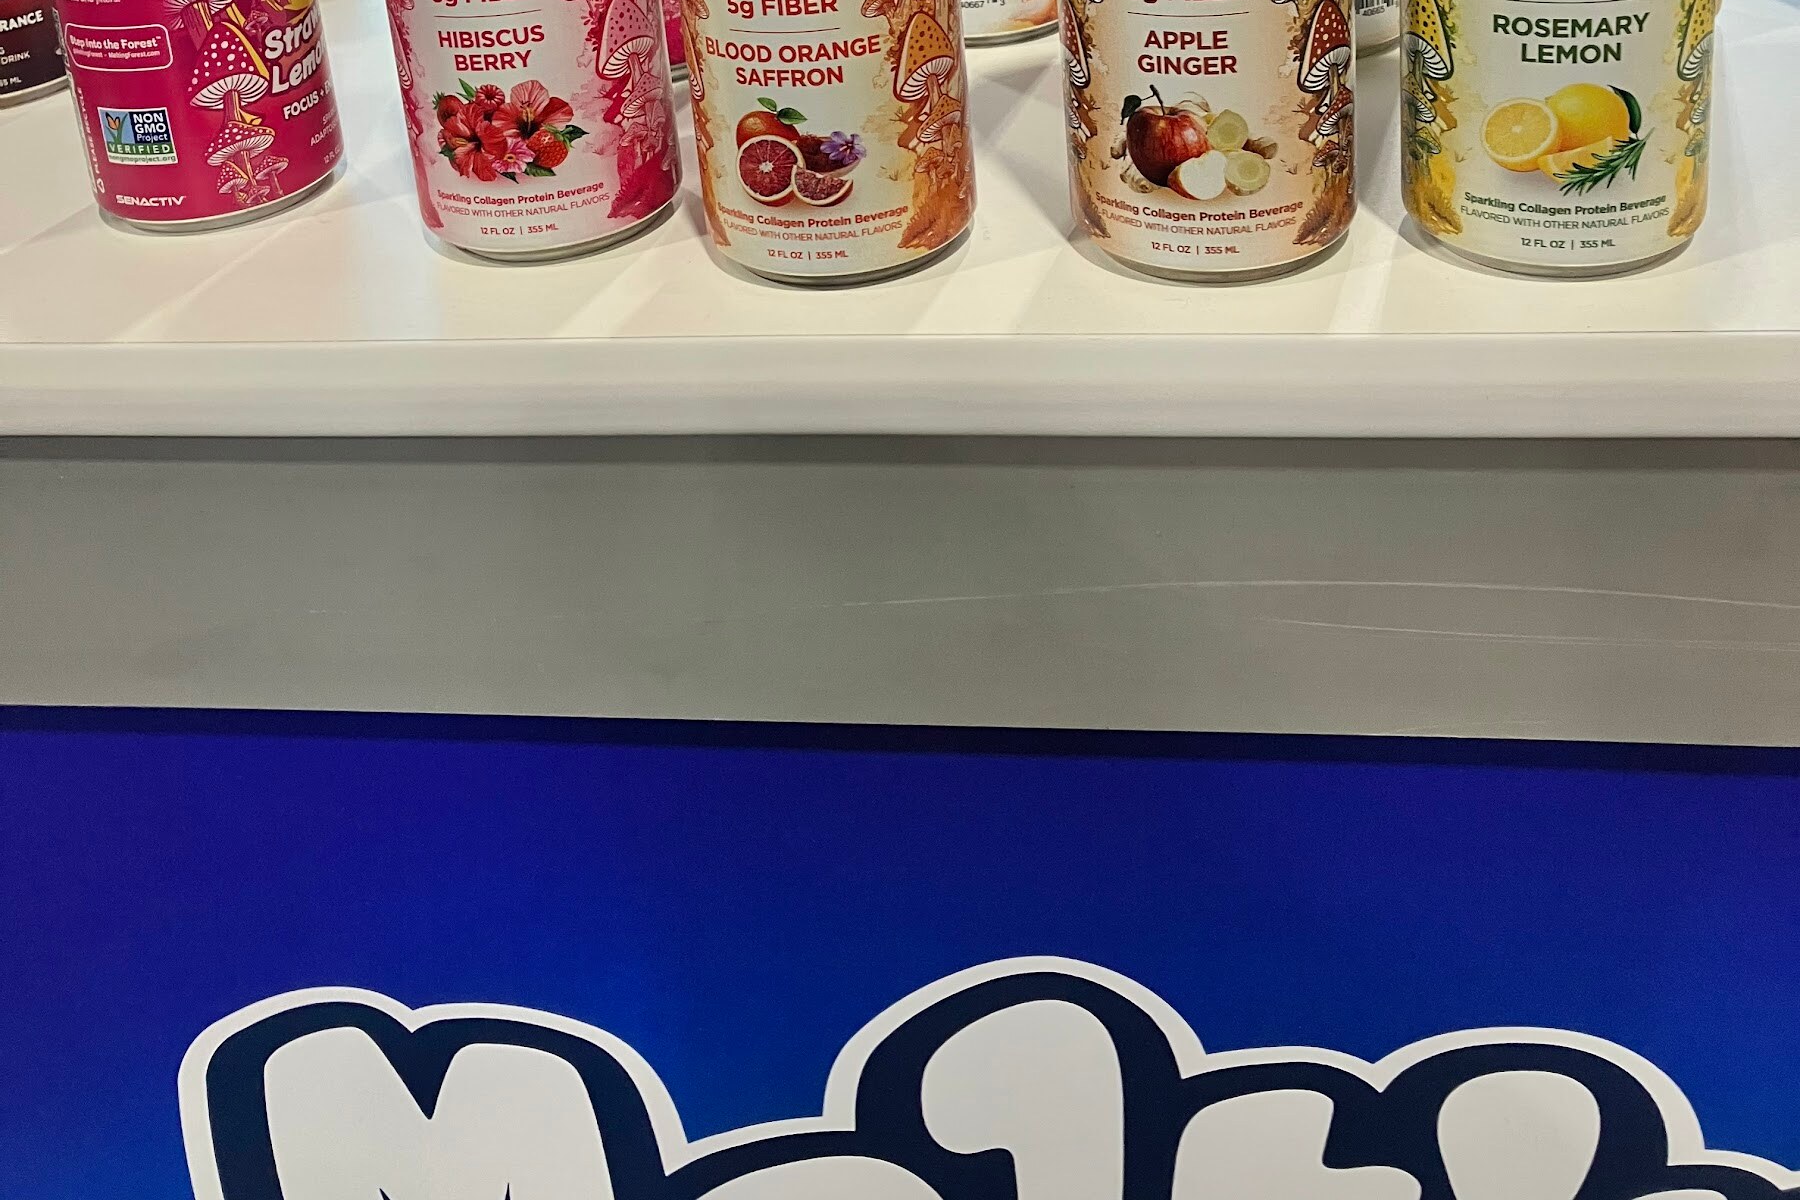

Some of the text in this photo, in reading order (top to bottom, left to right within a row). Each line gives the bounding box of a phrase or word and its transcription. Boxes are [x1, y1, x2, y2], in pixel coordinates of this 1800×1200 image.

[438, 24, 545, 49] HIBISCUS
[1493, 12, 1650, 39] ROSEMARY
[103, 39, 119, 49] the
[705, 34, 881, 64] BLOOD ORANGE
[1144, 30, 1228, 50] APPLE
[454, 49, 531, 72] BERRY
[1521, 42, 1622, 64] LEMON
[1137, 54, 1238, 76] GINGER
[736, 66, 844, 87] SAFFRON
[283, 91, 319, 120] FOCUS
[133, 112, 164, 124] NON
[135, 123, 167, 133] GMO
[109, 144, 170, 154] VERIFIED
[137, 133, 168, 143] Project
[116, 195, 185, 207] SENACTIV
[437, 182, 604, 206] Sparkling Collagen Protein Beverage
[1464, 191, 1666, 217] Sparkling Collagen Protein Beverage
[757, 215, 804, 229] Collagen
[808, 217, 851, 228] Protein
[855, 205, 908, 224] Beverage
[1096, 191, 1303, 222] Sparkling Collagen Protein Beverage
[1461, 205, 1670, 230] FLAVORED WITH OTHER NATURAL FLAVORS
[1521, 237, 1616, 249] 12 FL OZ 355 ML
